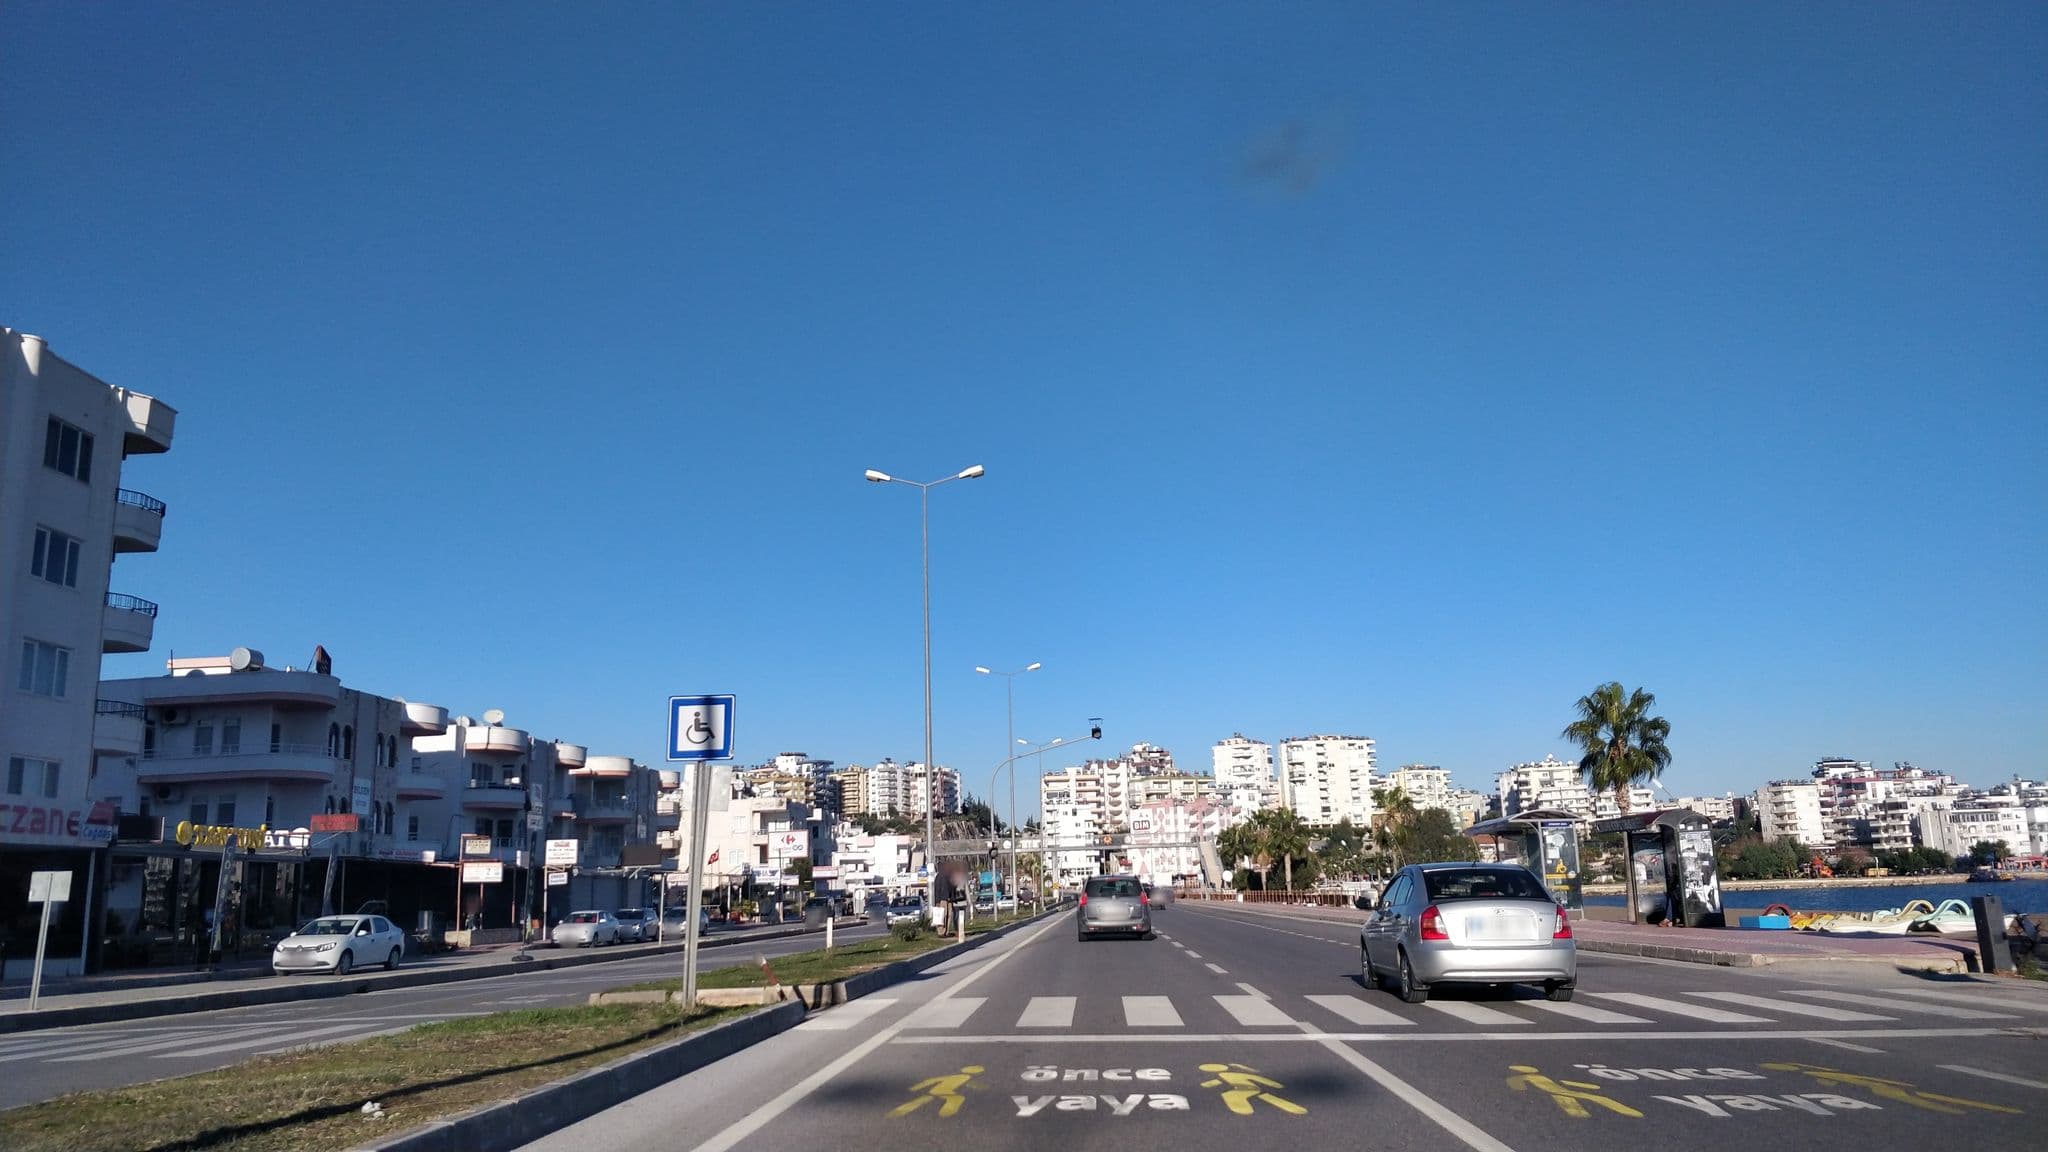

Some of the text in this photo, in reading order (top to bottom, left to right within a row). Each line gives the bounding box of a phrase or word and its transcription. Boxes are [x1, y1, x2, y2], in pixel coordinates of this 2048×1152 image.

[1021, 1065, 1172, 1080] önce
[1573, 1064, 1768, 1080] önce
[1011, 1094, 1190, 1116] yaya
[1651, 1093, 1884, 1117] yaya
